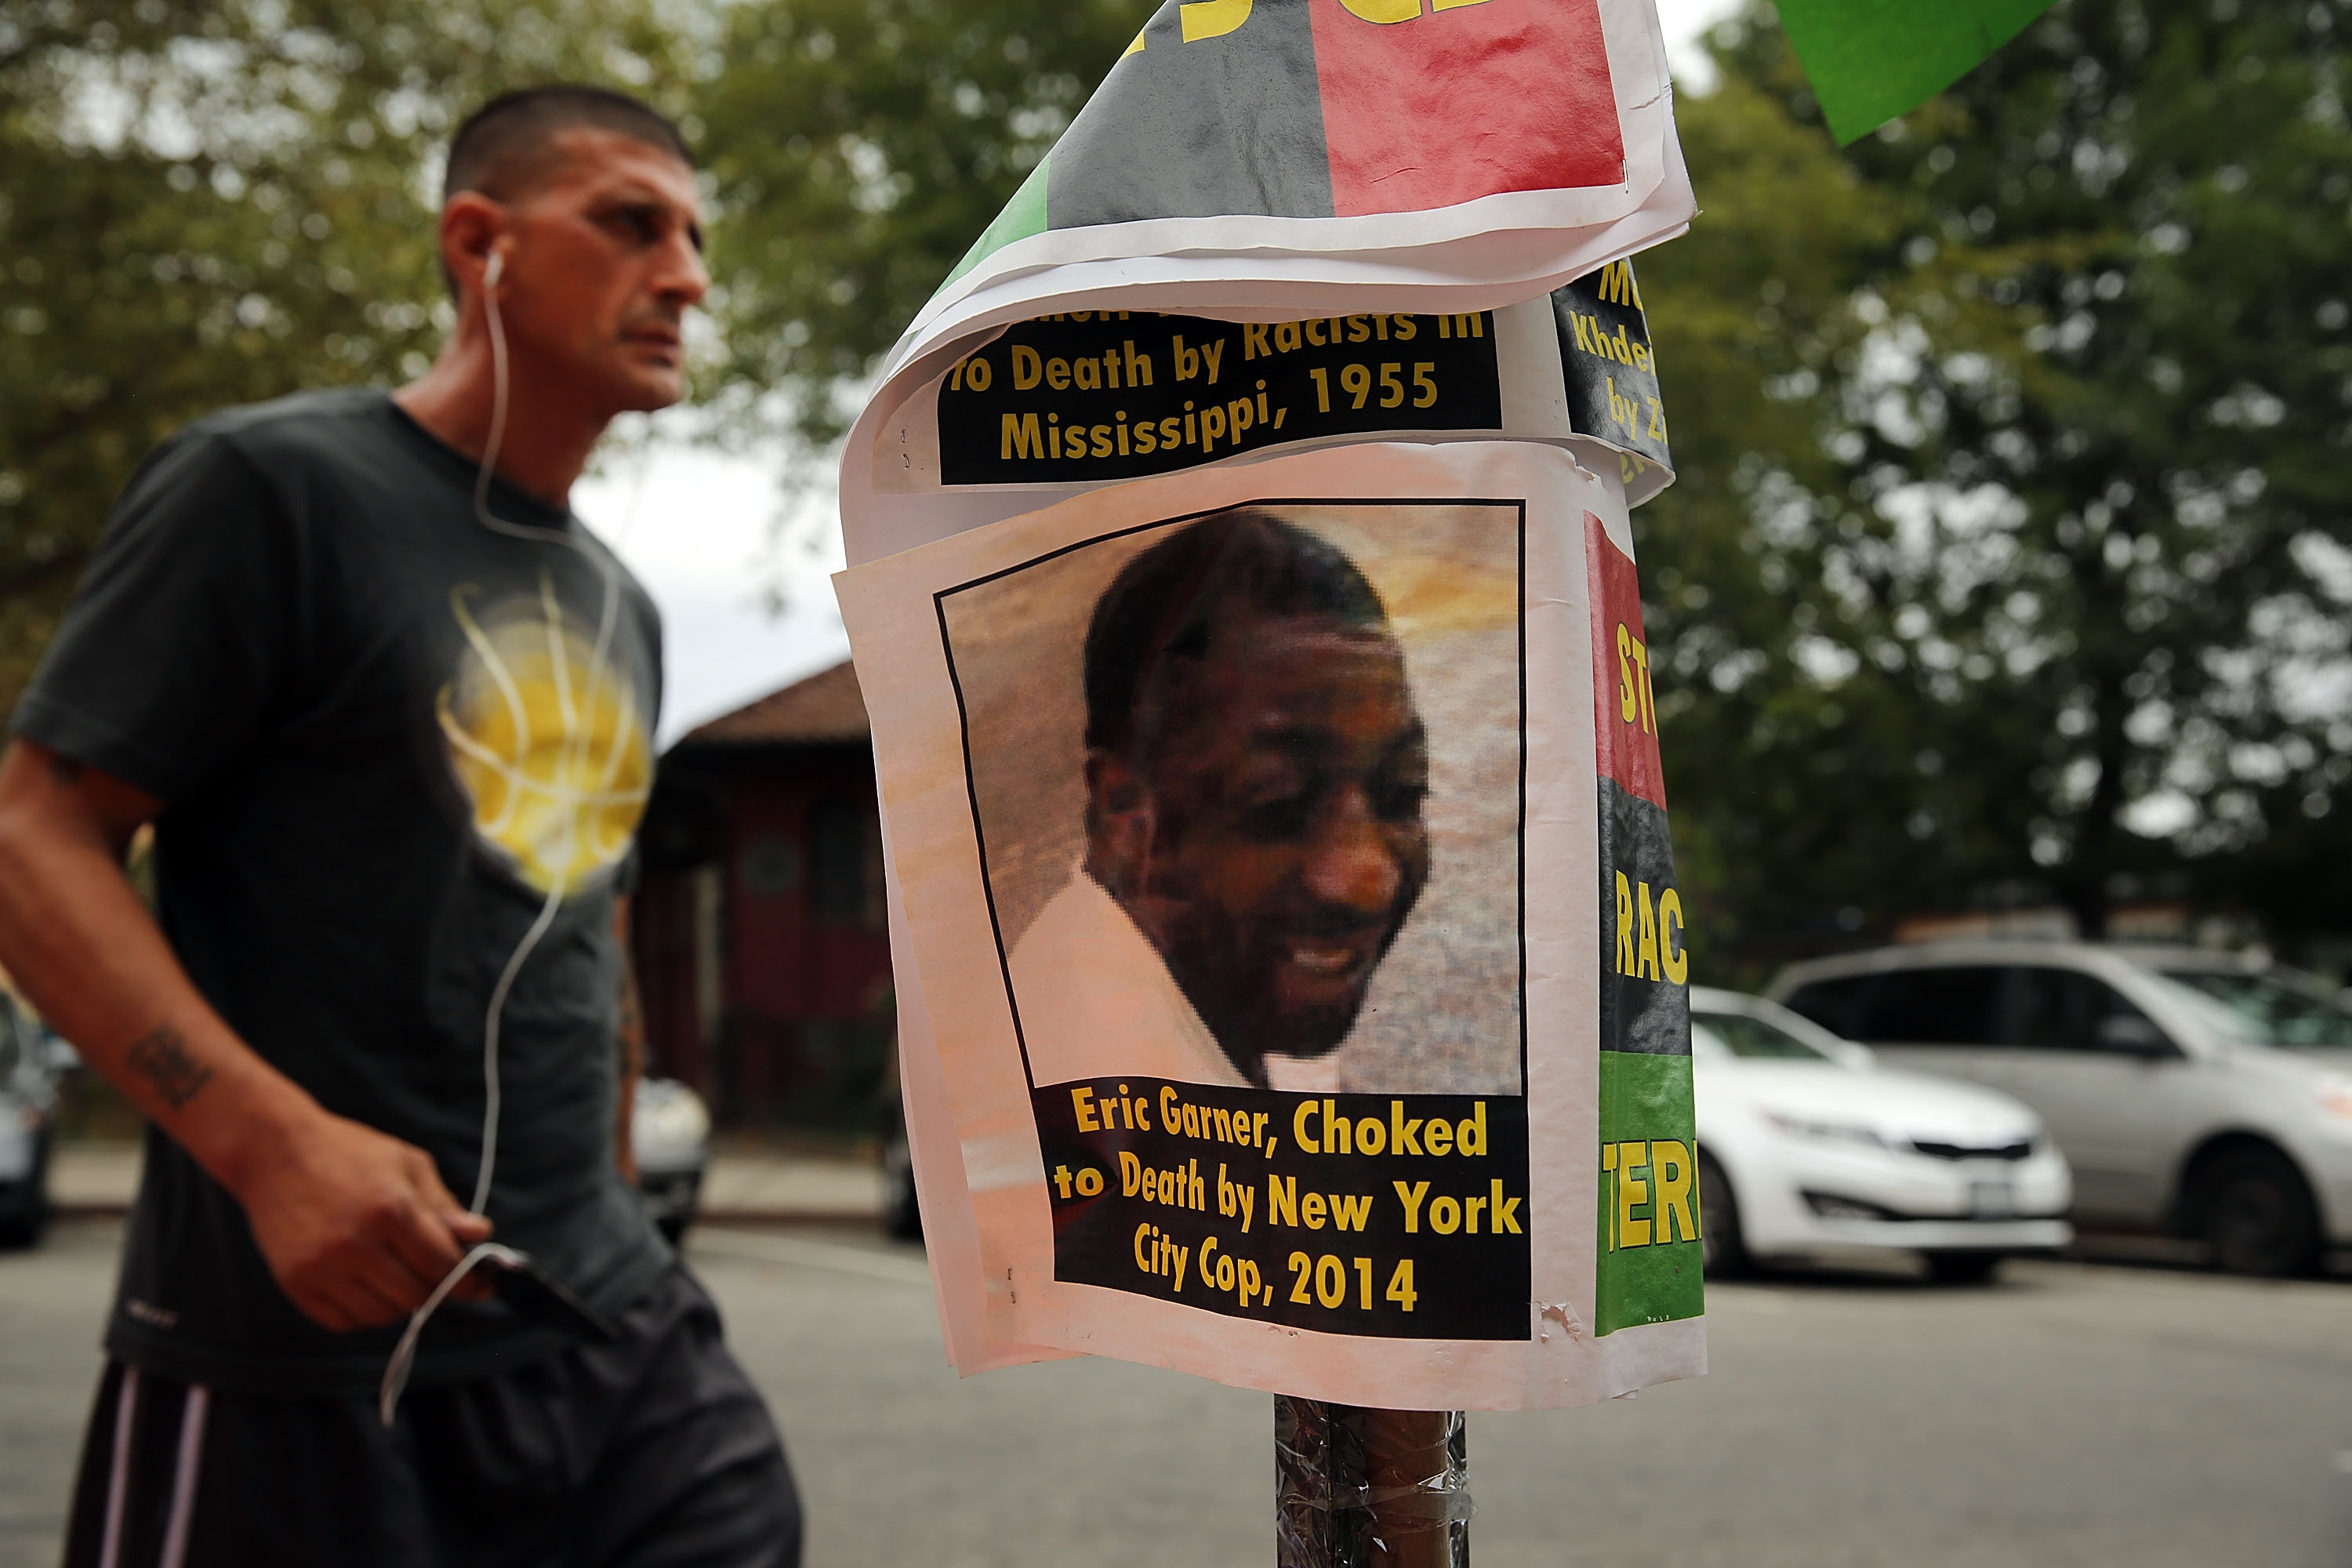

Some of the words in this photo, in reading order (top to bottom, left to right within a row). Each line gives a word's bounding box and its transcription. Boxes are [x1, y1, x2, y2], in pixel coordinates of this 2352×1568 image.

[1011, 340, 1153, 390] Death
[1173, 335, 1225, 385] by
[1243, 313, 1417, 361] Racists
[1001, 379, 1287, 459] Mississippi,
[1310, 362, 1438, 412] 1955
[1606, 376, 1639, 441] by
[1617, 622, 1658, 740] ST
[1616, 869, 1687, 985] RAC
[1071, 1084, 1151, 1133] Eric
[1160, 1086, 1278, 1159] Garner,
[1294, 1099, 1487, 1156] Choked
[1054, 1165, 1104, 1199] to
[1118, 1151, 1205, 1211] Death
[1218, 1163, 1254, 1233] by
[1269, 1174, 1374, 1232] New
[1392, 1179, 1523, 1235] York
[1602, 1138, 1701, 1254] TER
[1134, 1223, 1189, 1292] City
[1200, 1236, 1273, 1307] Cop,
[1288, 1251, 1417, 1312] 2014
